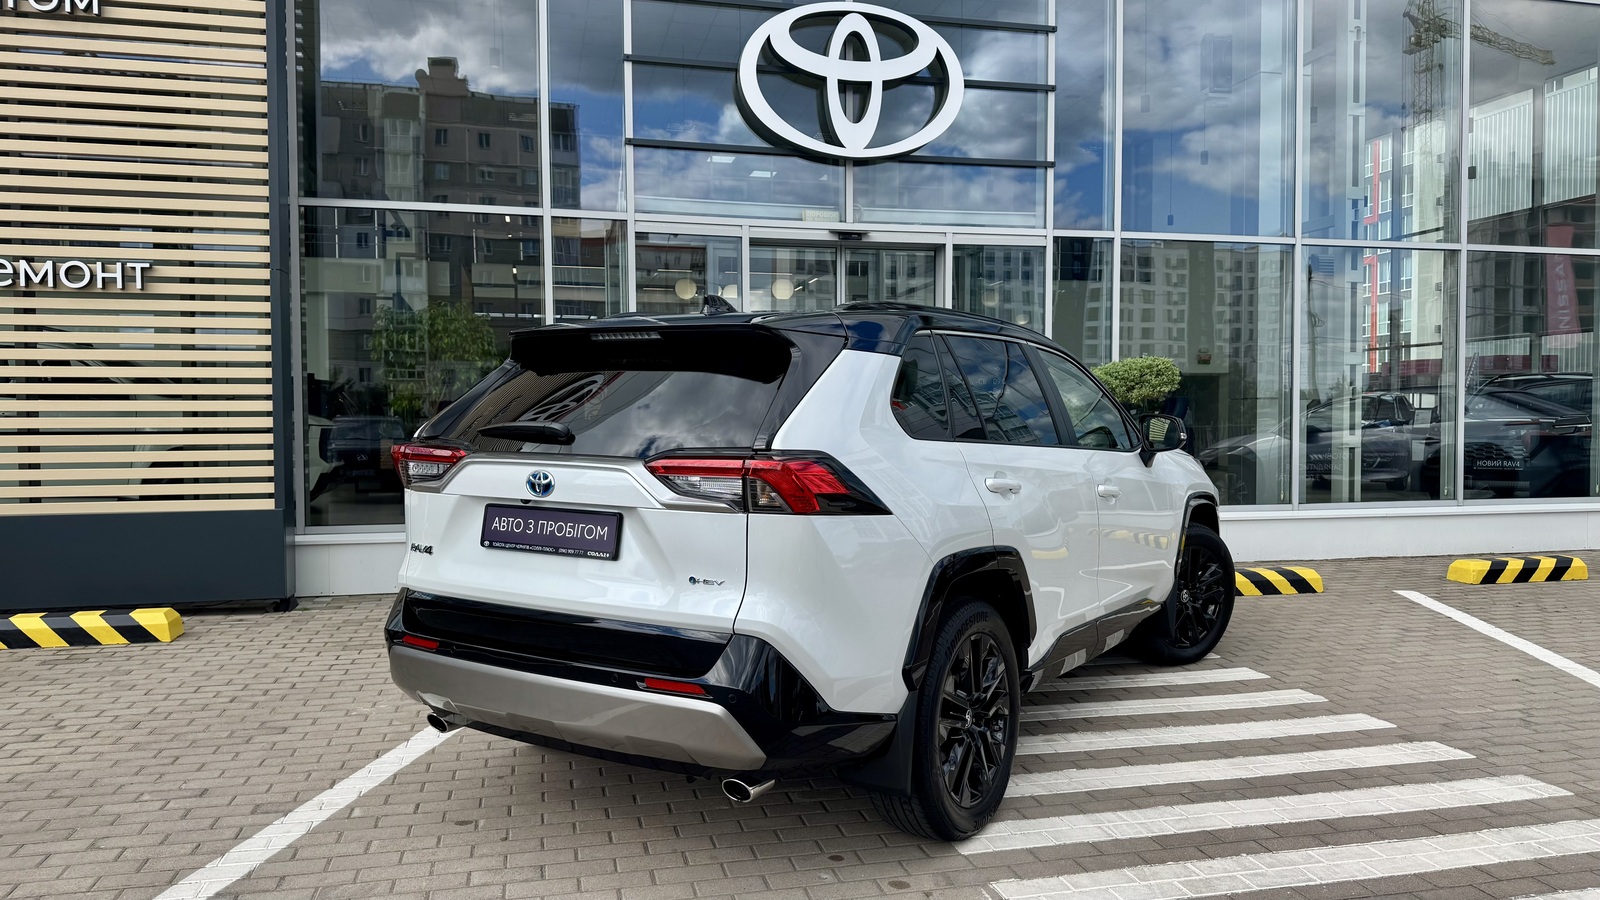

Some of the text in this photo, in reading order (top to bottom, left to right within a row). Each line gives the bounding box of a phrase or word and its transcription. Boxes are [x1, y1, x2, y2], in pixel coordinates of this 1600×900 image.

[1476, 459, 1502, 467] НОВИЙ
[491, 516, 608, 540] АВТО З ПРОБІГОМ
[410, 542, 434, 556] RAV4
